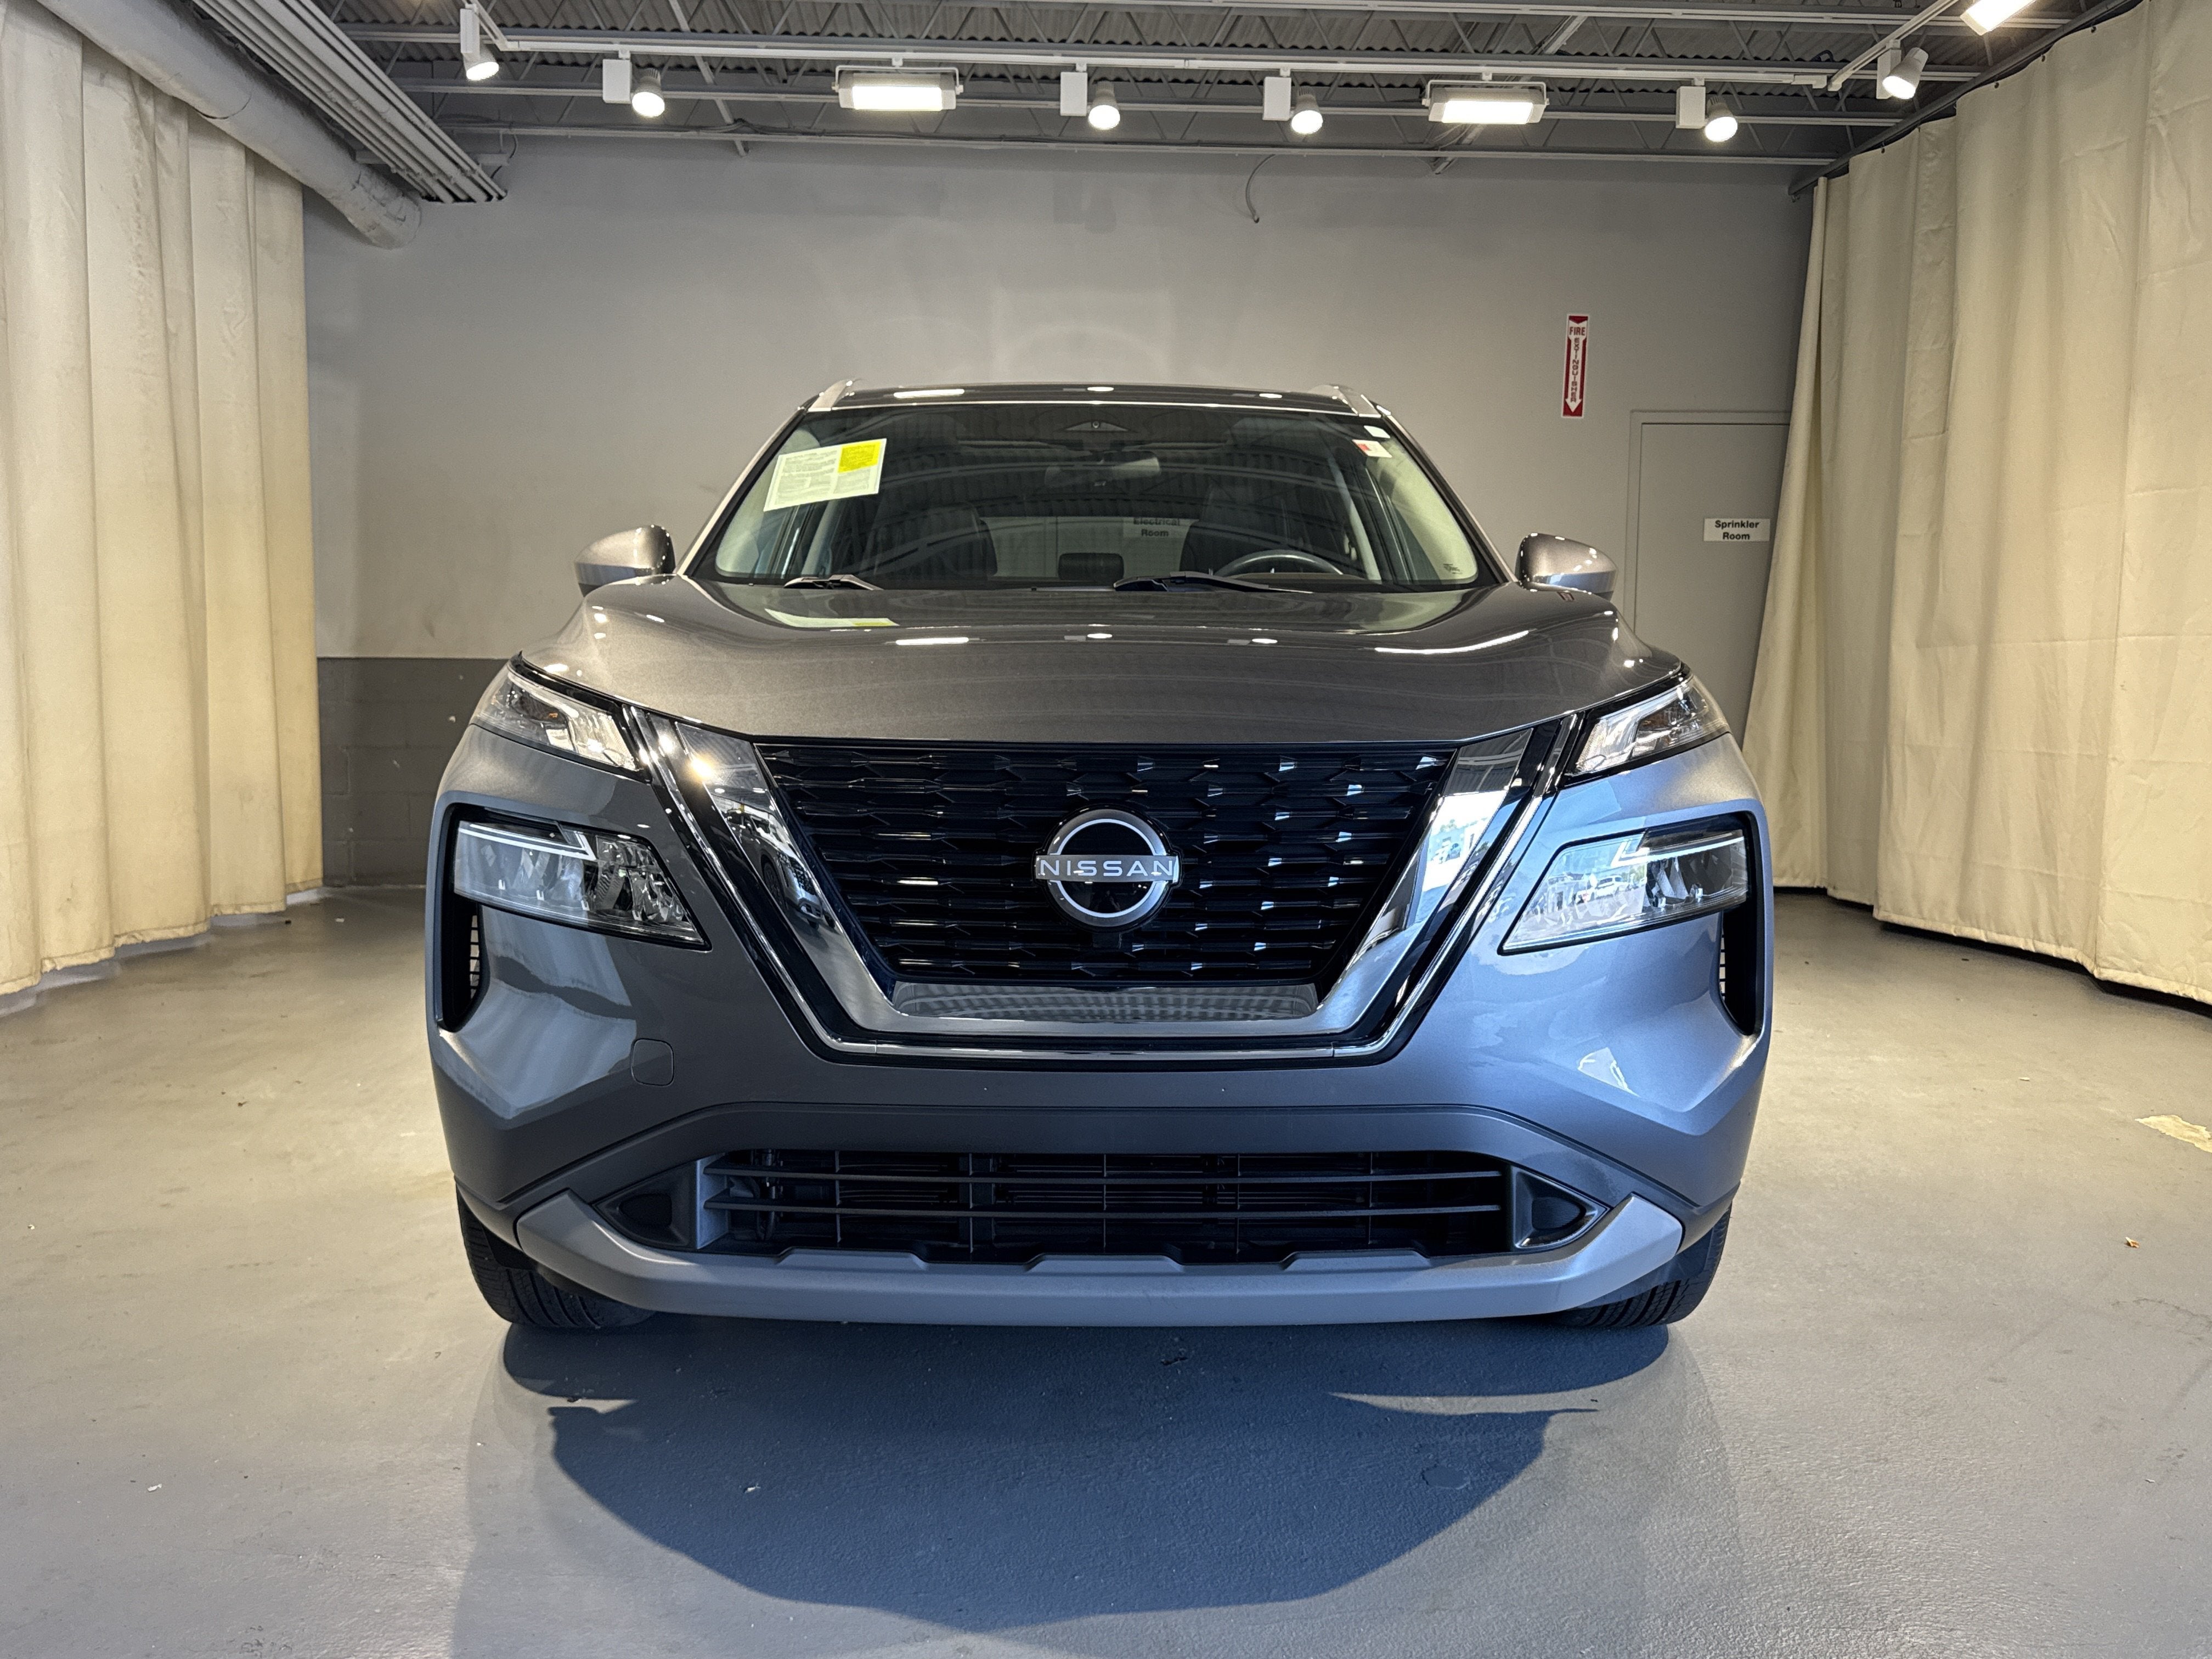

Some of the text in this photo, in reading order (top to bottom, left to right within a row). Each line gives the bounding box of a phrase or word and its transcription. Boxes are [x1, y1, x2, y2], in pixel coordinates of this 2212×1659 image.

[1569, 326, 1585, 336] FIRE
[1571, 337, 1579, 403] EXTINGUISHER
[1714, 520, 1760, 529] Sprinkler
[1723, 532, 1750, 540] Room
[1040, 860, 1173, 877] NISSAN
